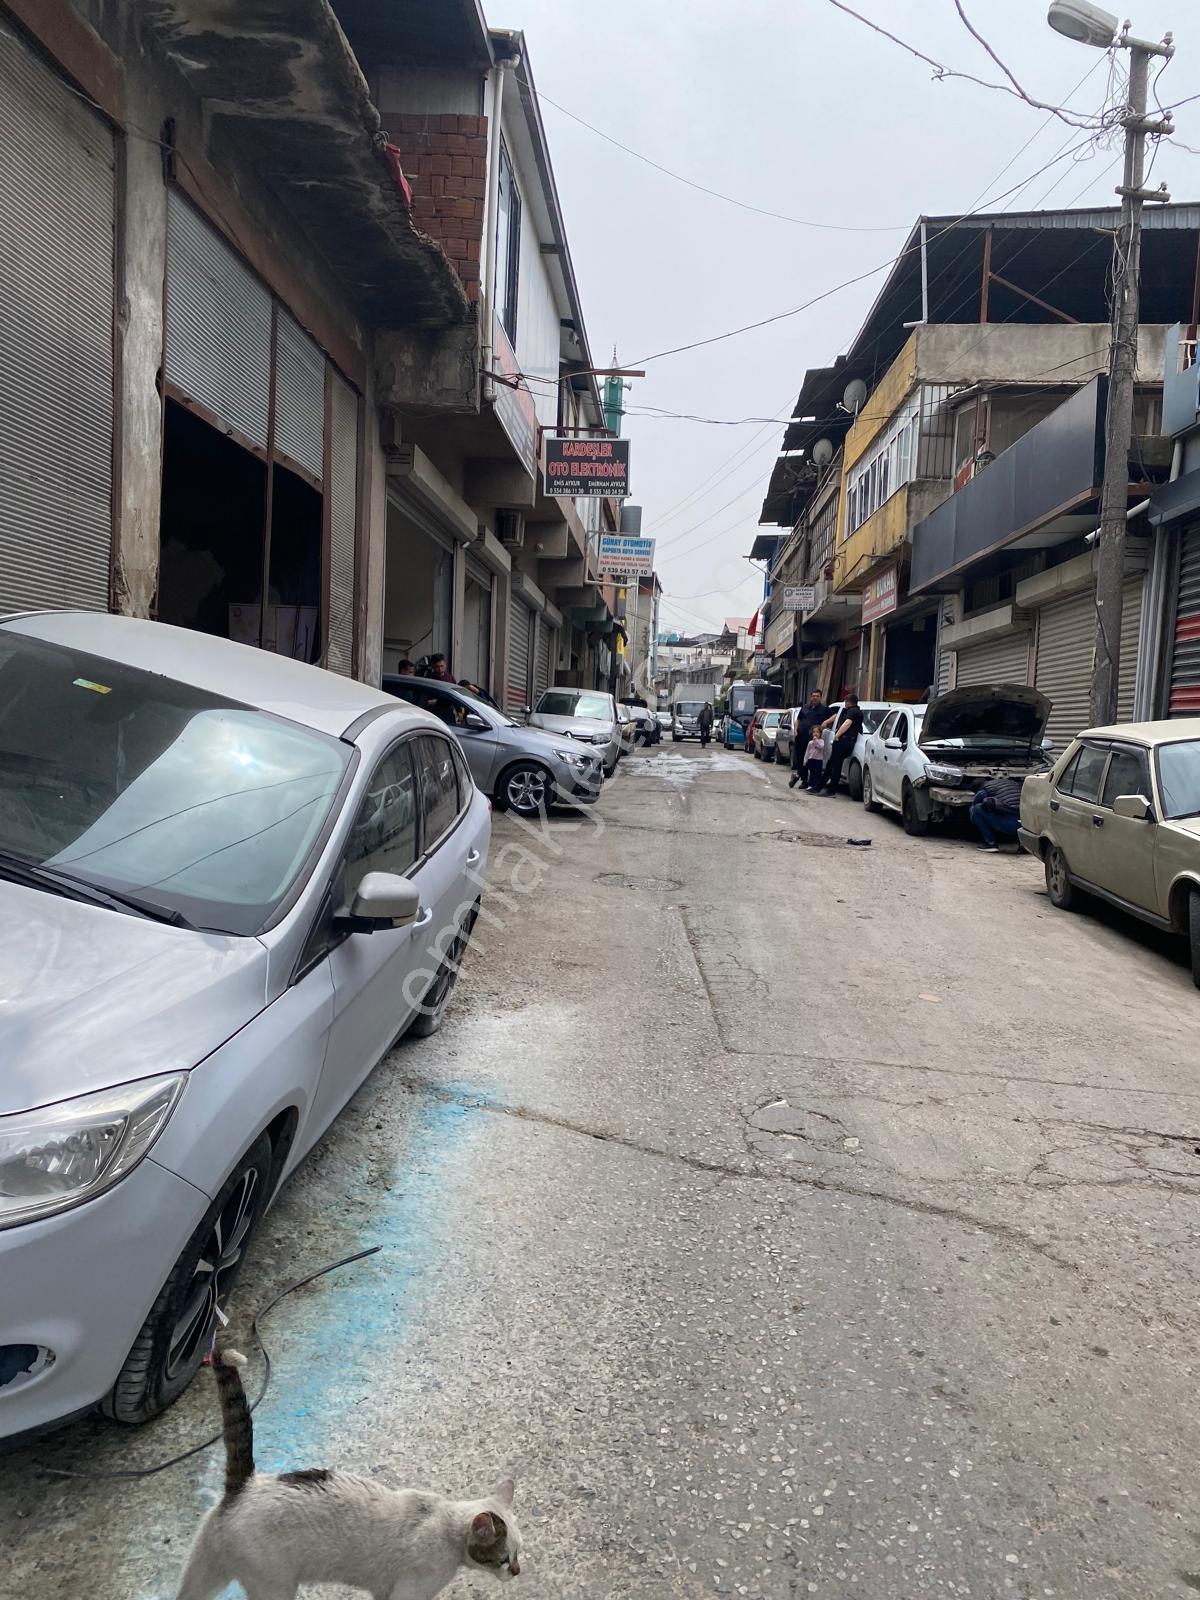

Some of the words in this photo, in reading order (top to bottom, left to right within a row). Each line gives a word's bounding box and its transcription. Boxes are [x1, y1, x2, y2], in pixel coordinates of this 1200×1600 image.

[563, 442, 613, 460] KARDEŞLER
[548, 462, 569, 476] OTO
[571, 460, 626, 477] ELEKTRONİK
[623, 539, 653, 548] OTOMOTİV
